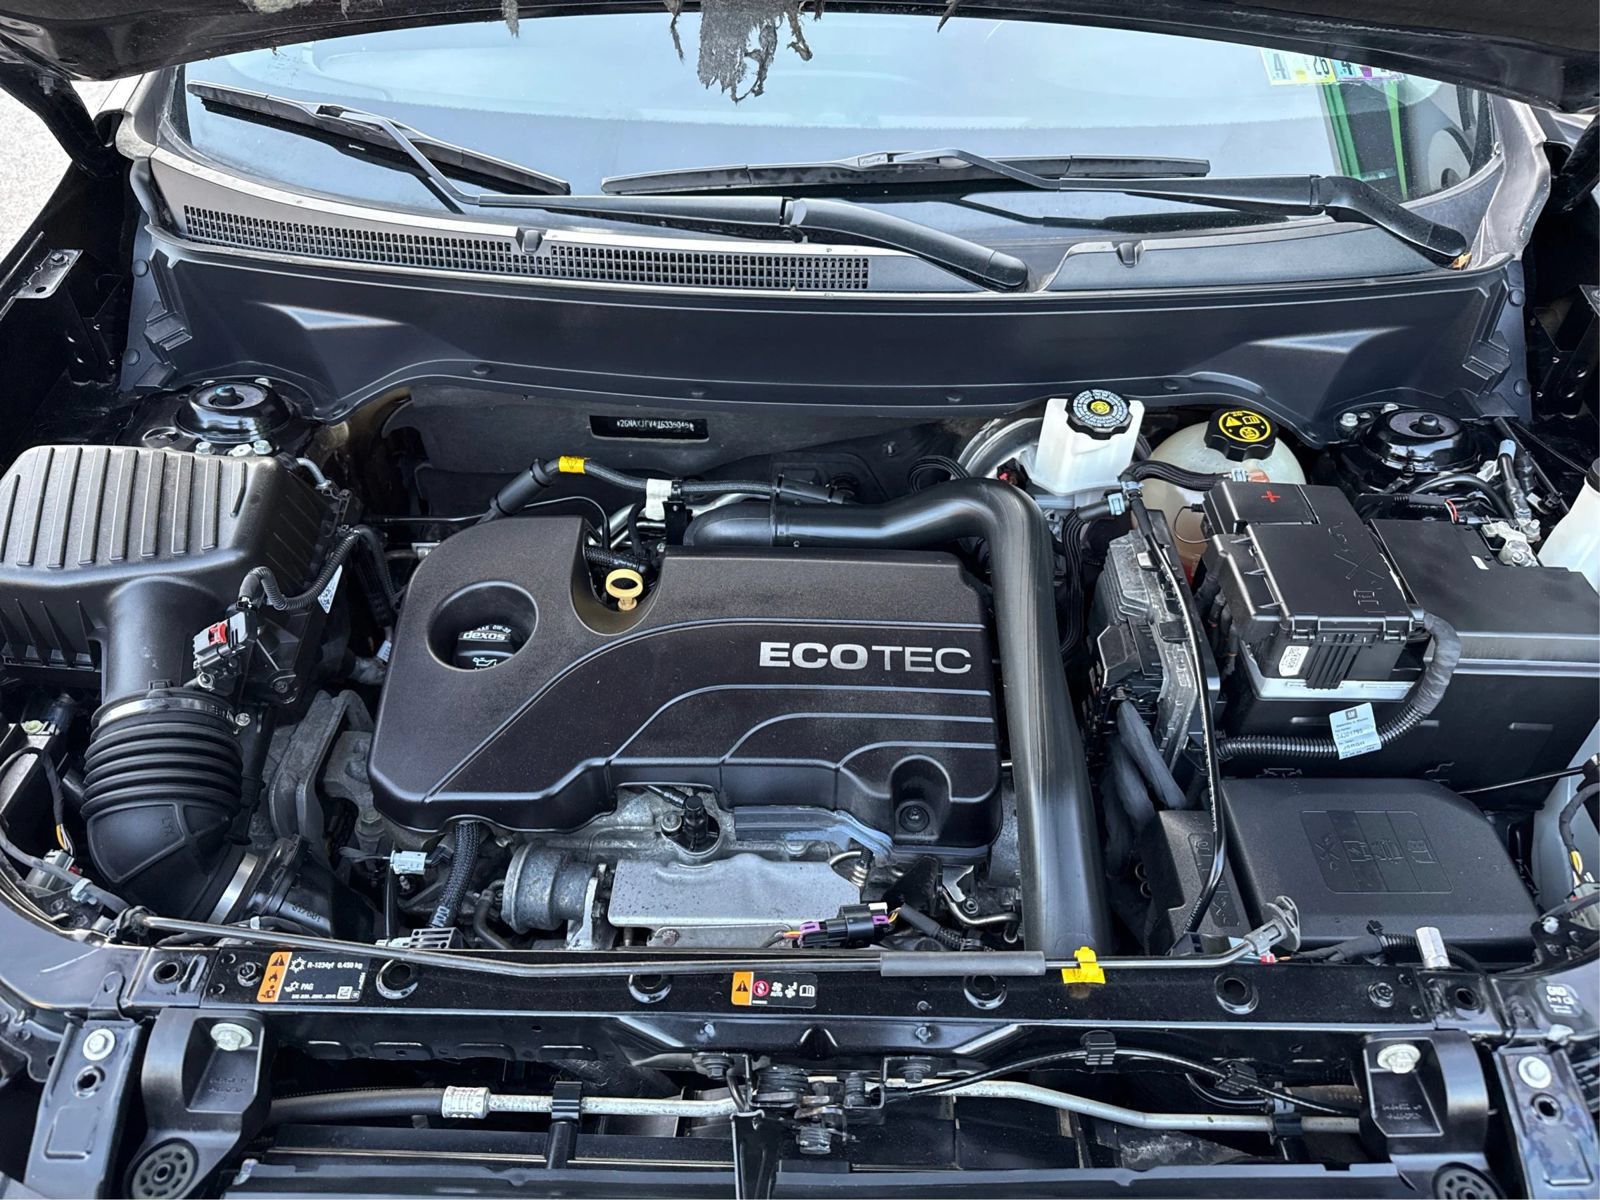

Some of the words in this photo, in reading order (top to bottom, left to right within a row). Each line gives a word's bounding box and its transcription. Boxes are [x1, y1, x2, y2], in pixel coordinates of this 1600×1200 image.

[1273, 53, 1286, 79] 4
[462, 630, 507, 641] dexos
[759, 641, 972, 674] ECOTEC
[300, 983, 314, 991] PAG
